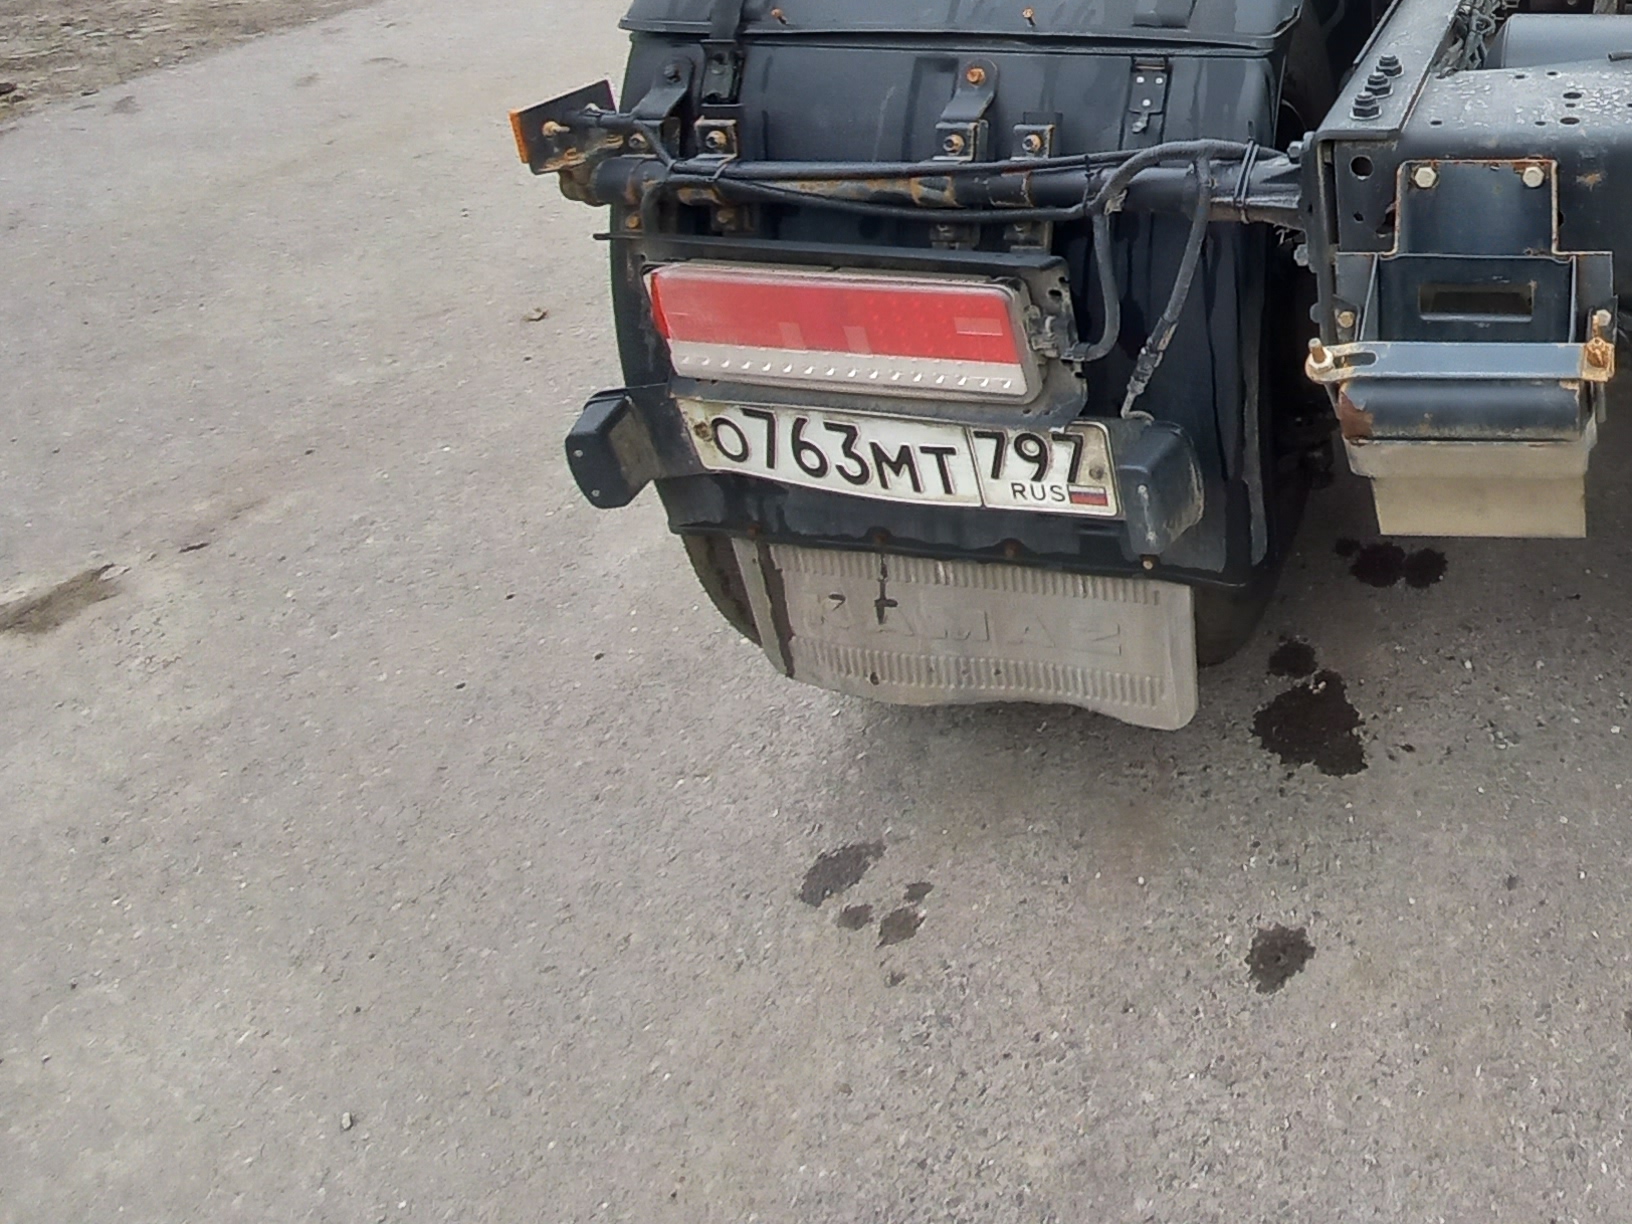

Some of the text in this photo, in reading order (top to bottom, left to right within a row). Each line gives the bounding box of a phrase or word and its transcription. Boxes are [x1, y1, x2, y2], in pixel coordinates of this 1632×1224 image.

[711, 407, 1085, 495] O763MT 797
[1010, 482, 1067, 503] RUS
